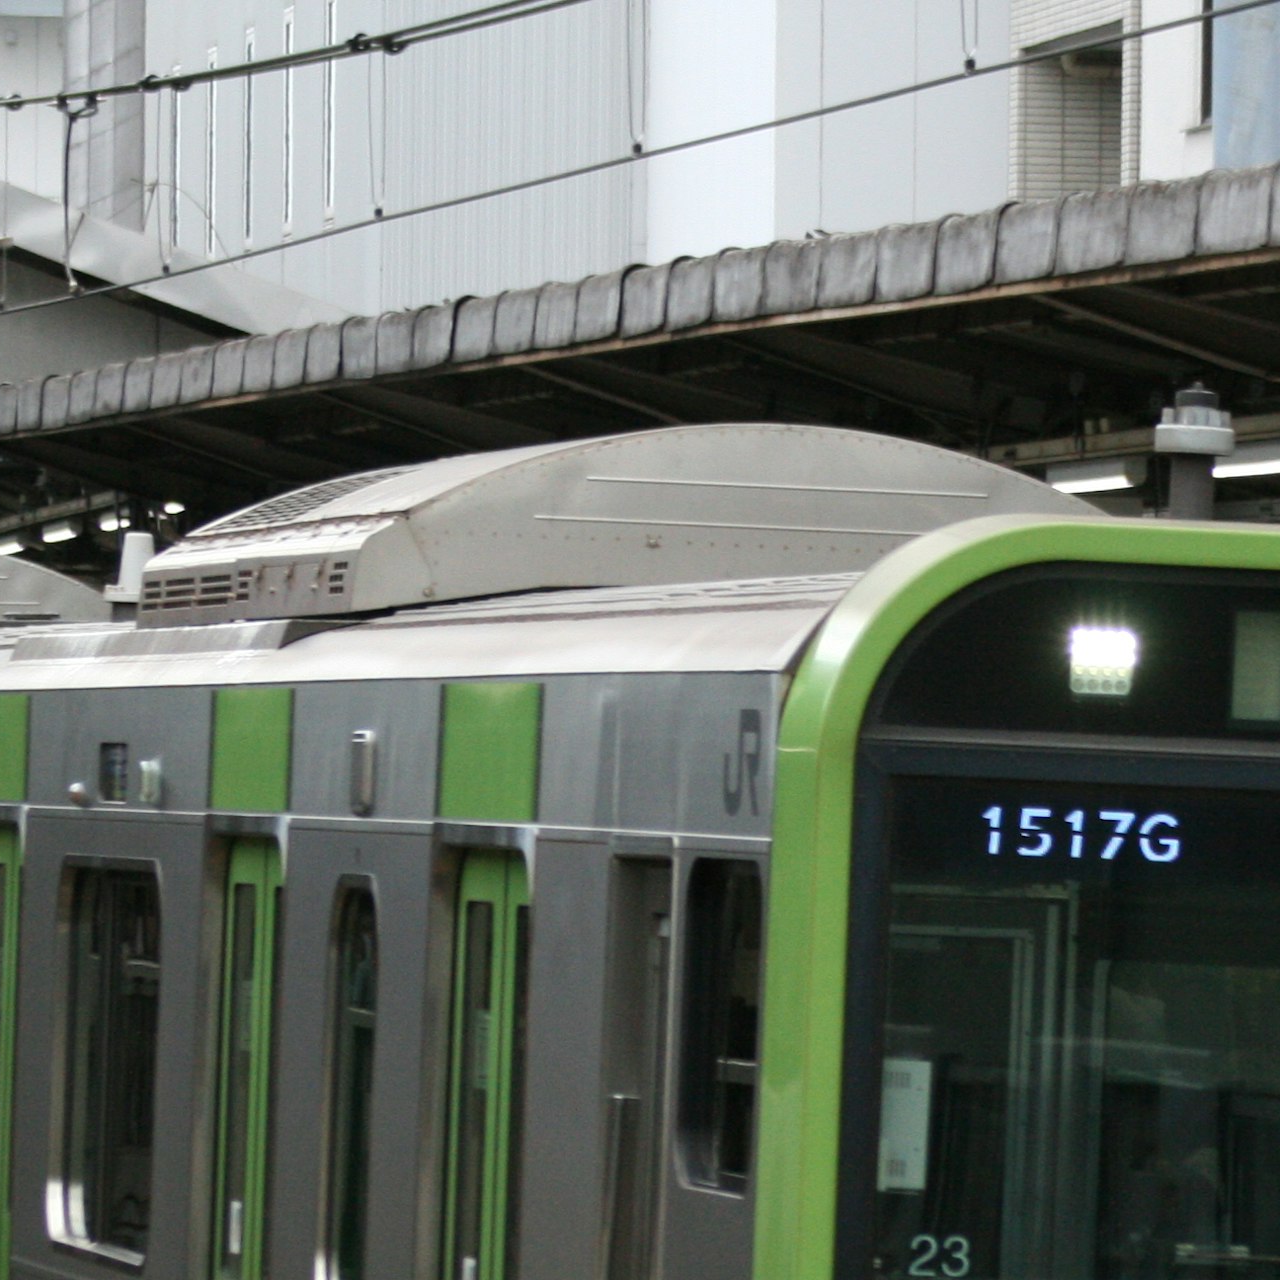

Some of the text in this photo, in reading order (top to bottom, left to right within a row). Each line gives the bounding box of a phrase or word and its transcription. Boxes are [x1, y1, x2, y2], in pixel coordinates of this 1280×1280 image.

[723, 708, 761, 817] JR
[980, 806, 1182, 862] 1517G
[907, 1233, 971, 1278] 23
